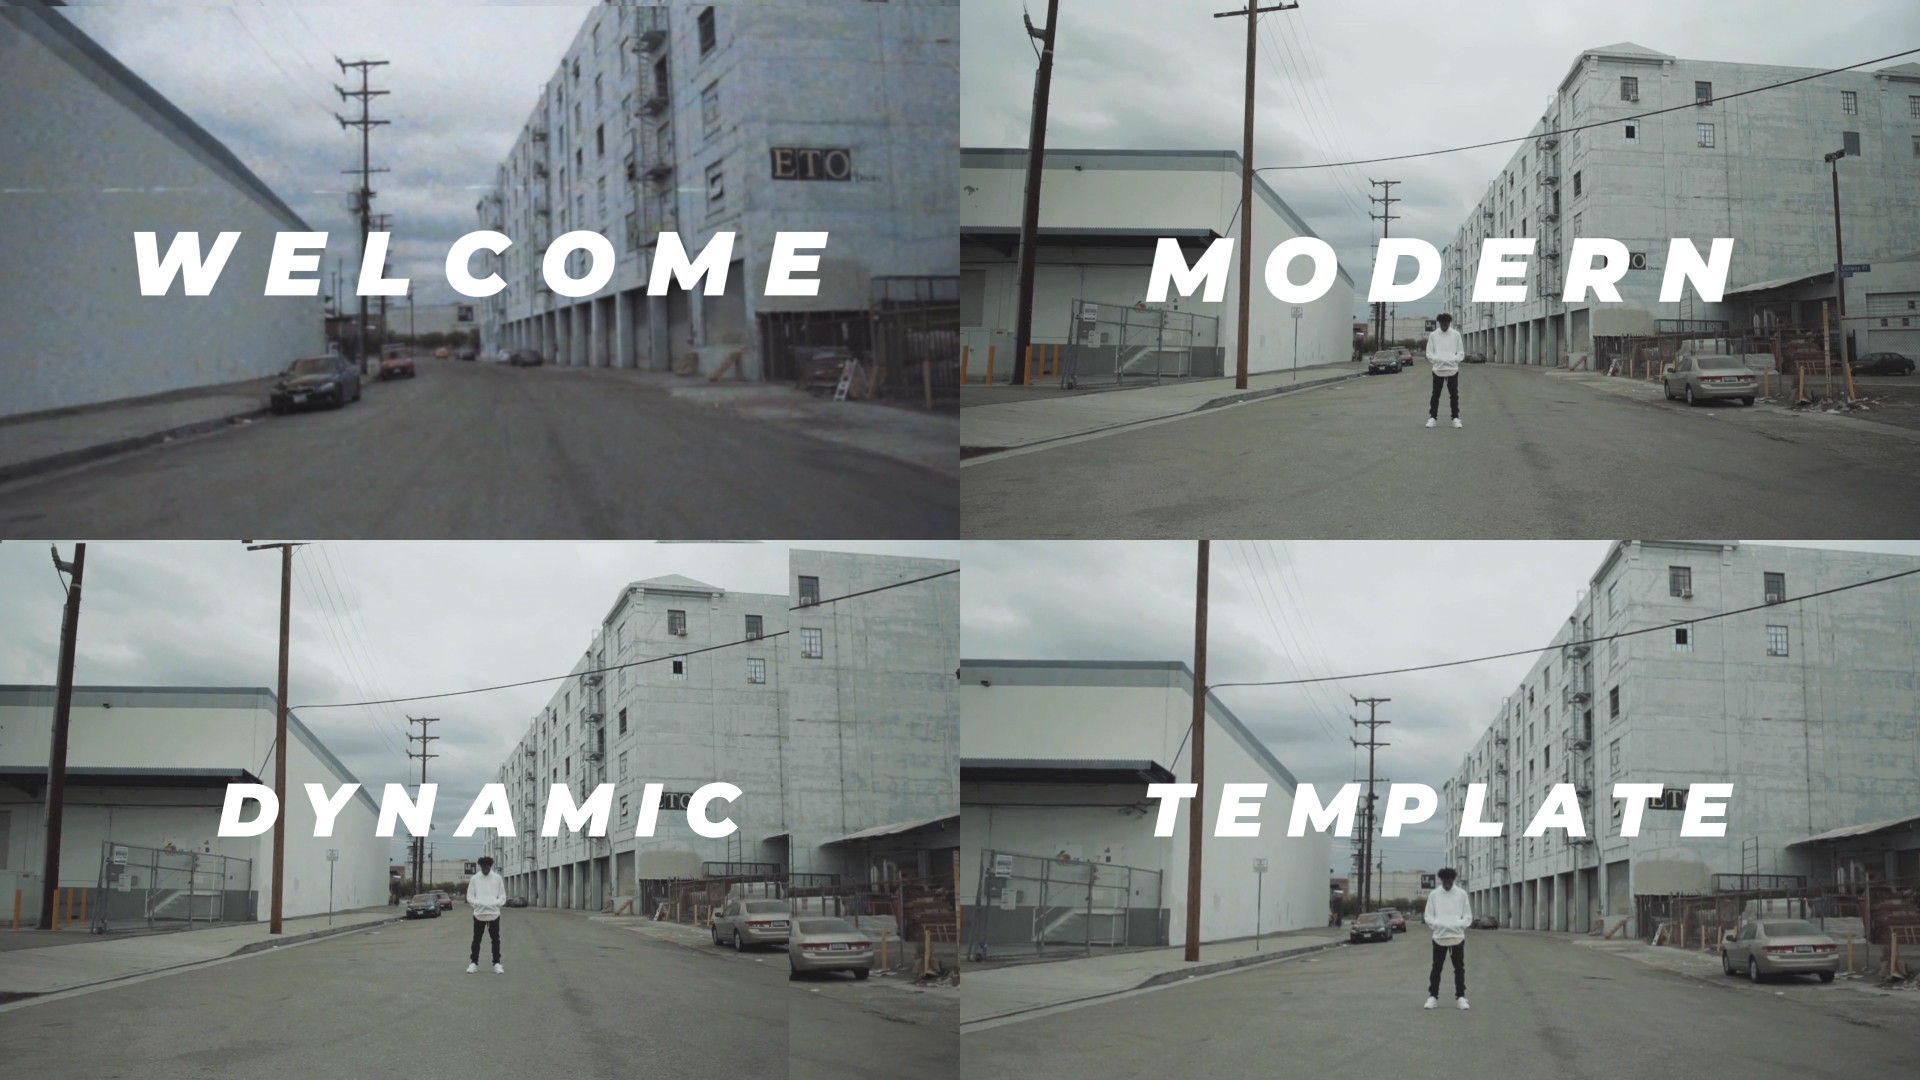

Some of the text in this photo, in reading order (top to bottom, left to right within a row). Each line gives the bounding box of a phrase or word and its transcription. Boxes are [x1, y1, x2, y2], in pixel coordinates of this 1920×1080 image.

[774, 149, 850, 179] ETO
[659, 793, 692, 809] TO
[1651, 790, 1689, 808] ET
